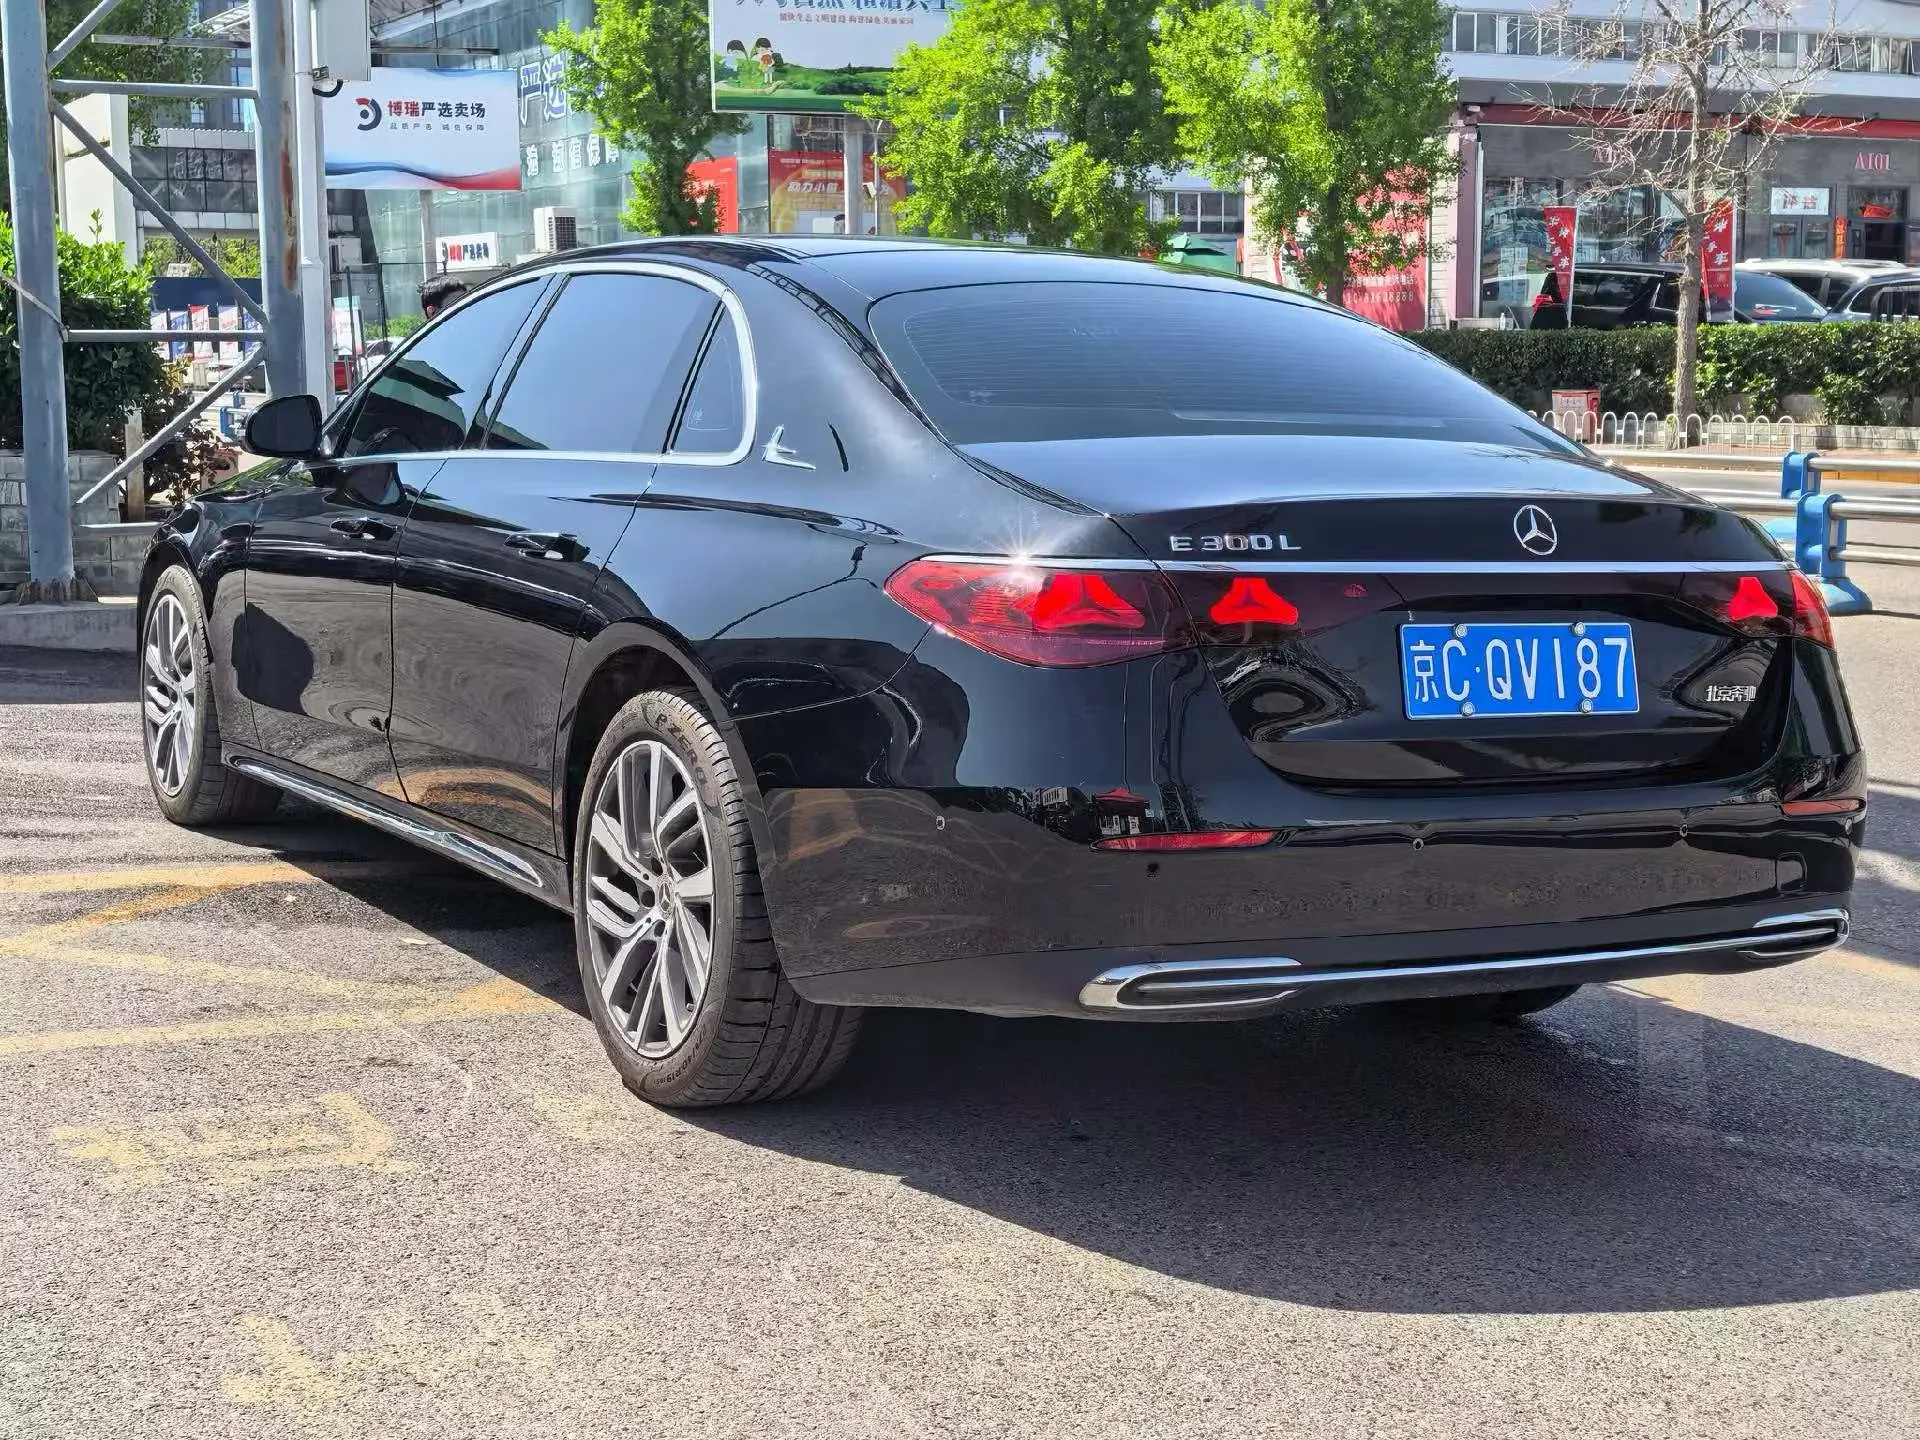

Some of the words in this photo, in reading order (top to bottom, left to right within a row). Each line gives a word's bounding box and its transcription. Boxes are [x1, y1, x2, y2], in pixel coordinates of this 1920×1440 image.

[388, 101, 486, 118] 博瑞严选卖场
[1170, 536, 1193, 551] E
[1201, 535, 1273, 551] 300
[1279, 534, 1302, 550] L
[1706, 685, 1757, 702] 北京奔驰
